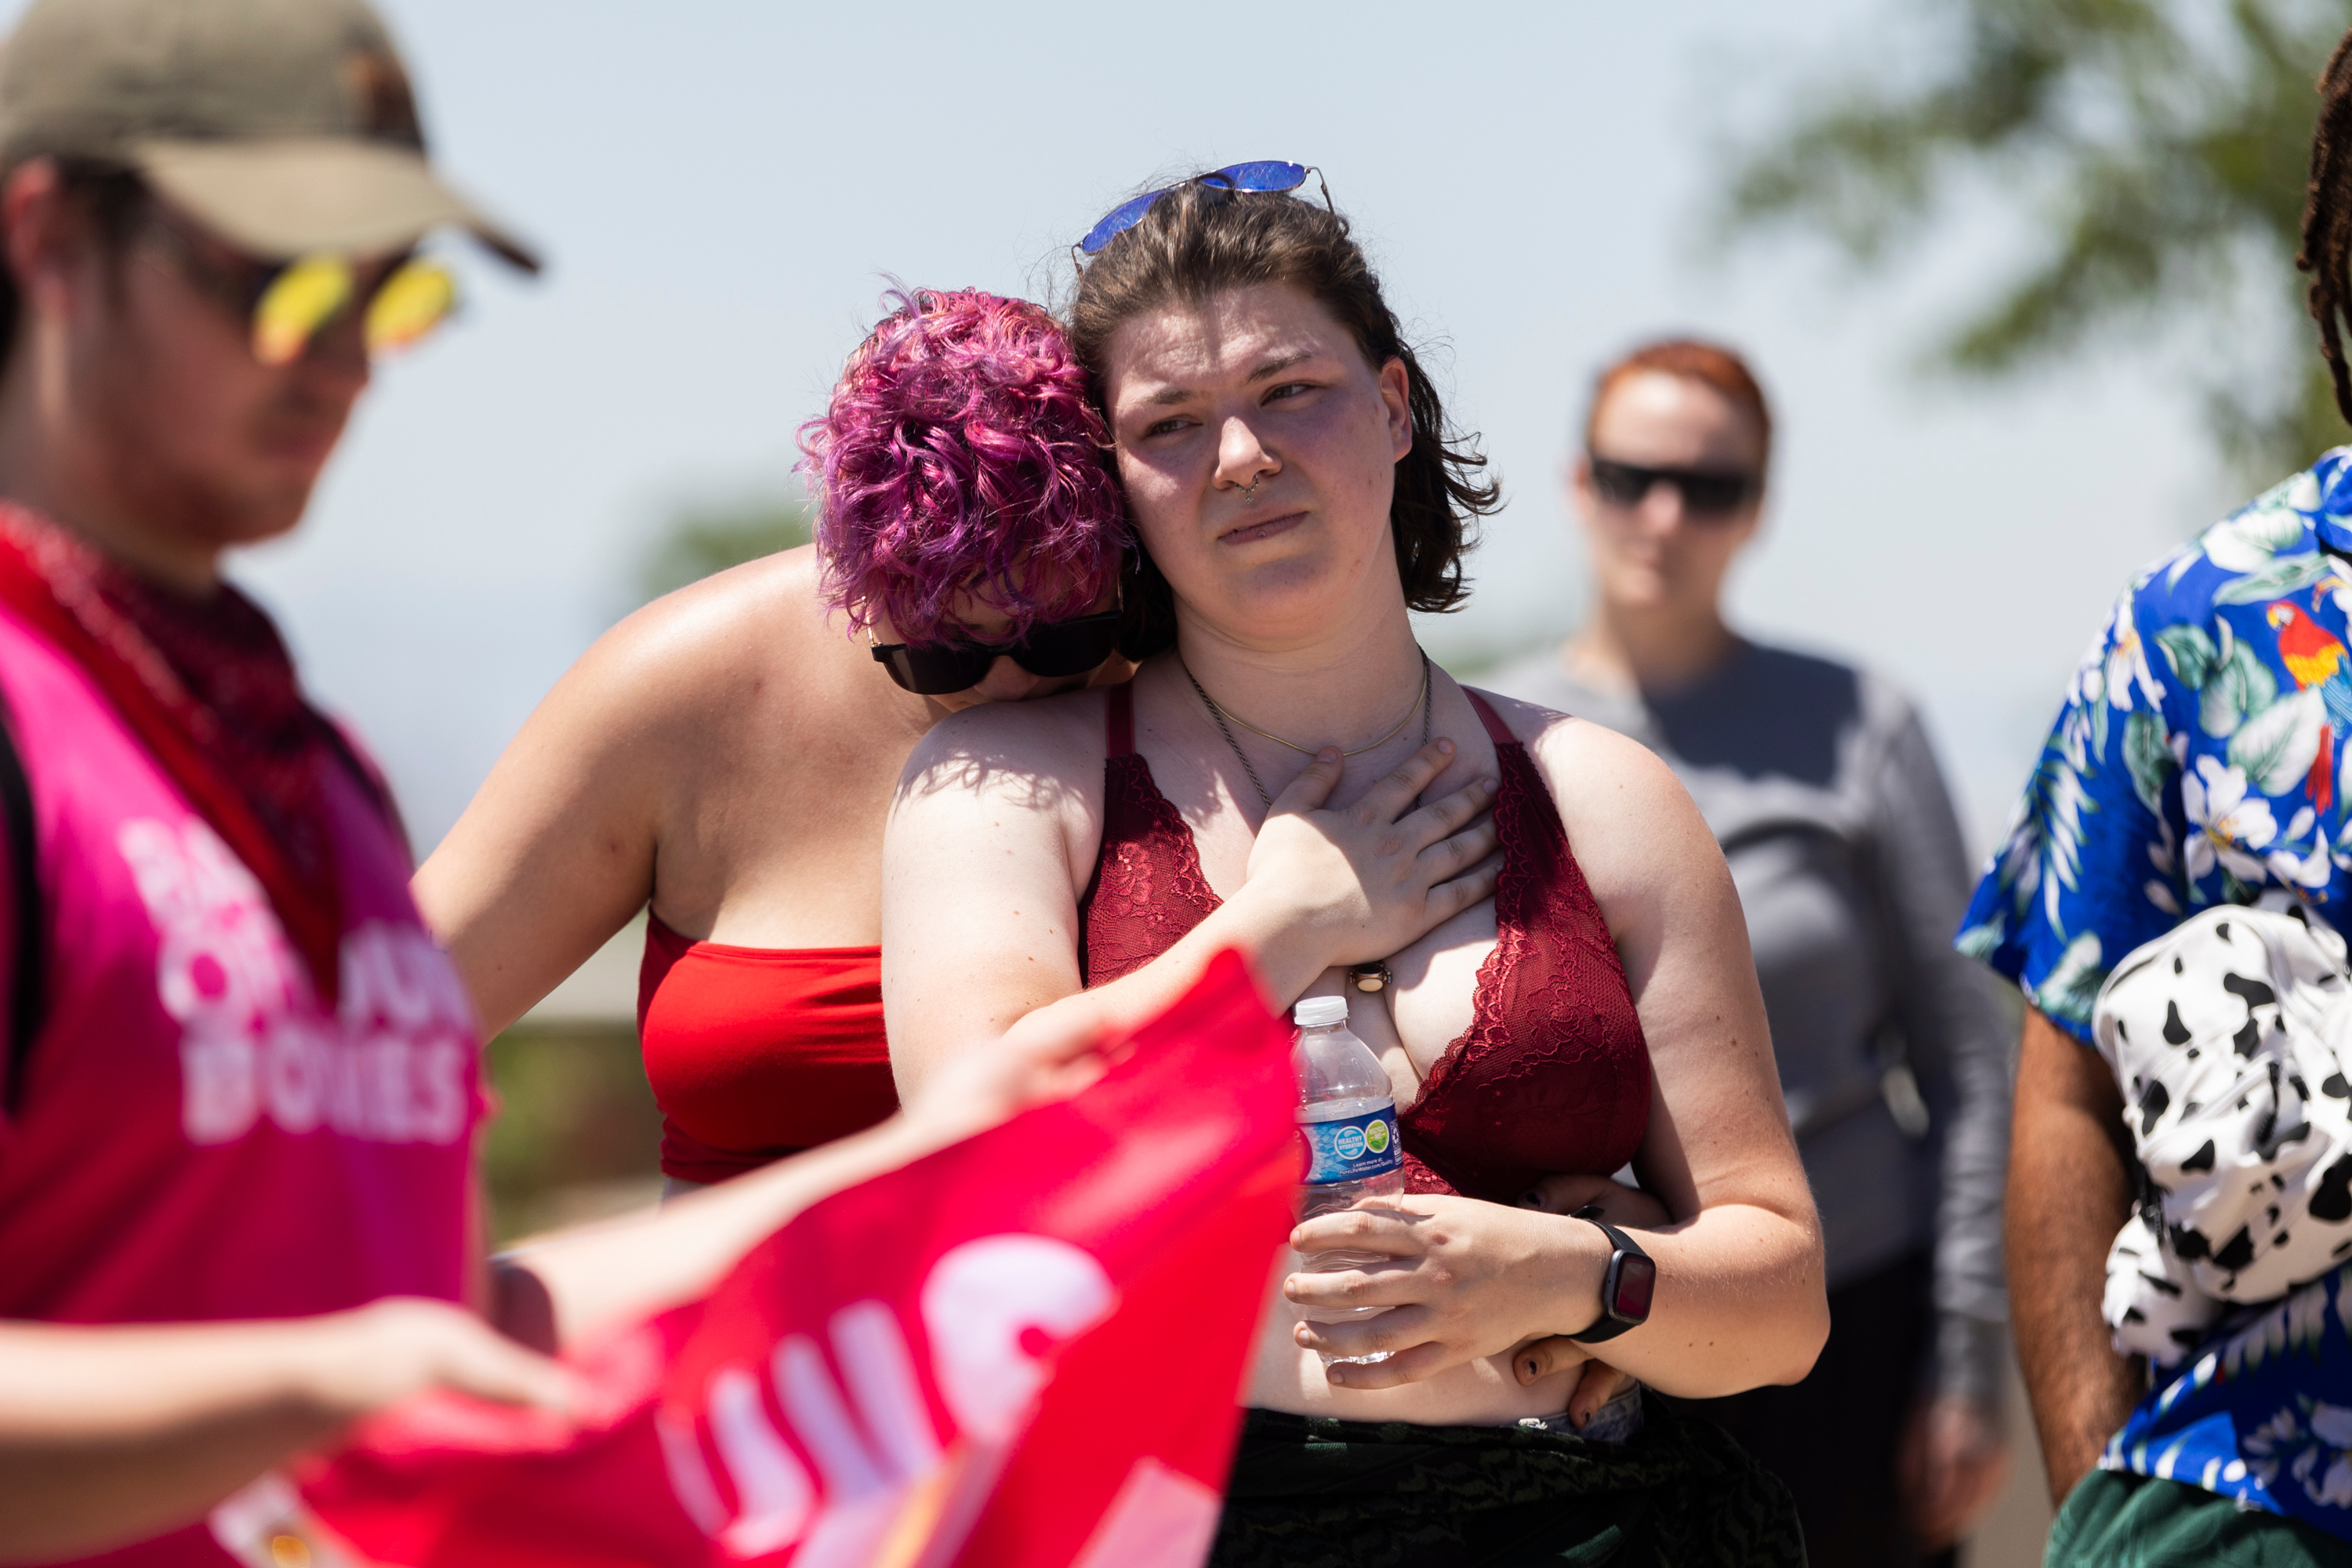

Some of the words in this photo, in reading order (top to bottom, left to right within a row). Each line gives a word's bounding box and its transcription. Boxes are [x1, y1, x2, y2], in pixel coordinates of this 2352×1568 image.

[1369, 1125, 1385, 1135] RECYCLE
[1338, 1135, 1363, 1145] HEALTHY
[1338, 1142, 1363, 1150] HYDRATION
